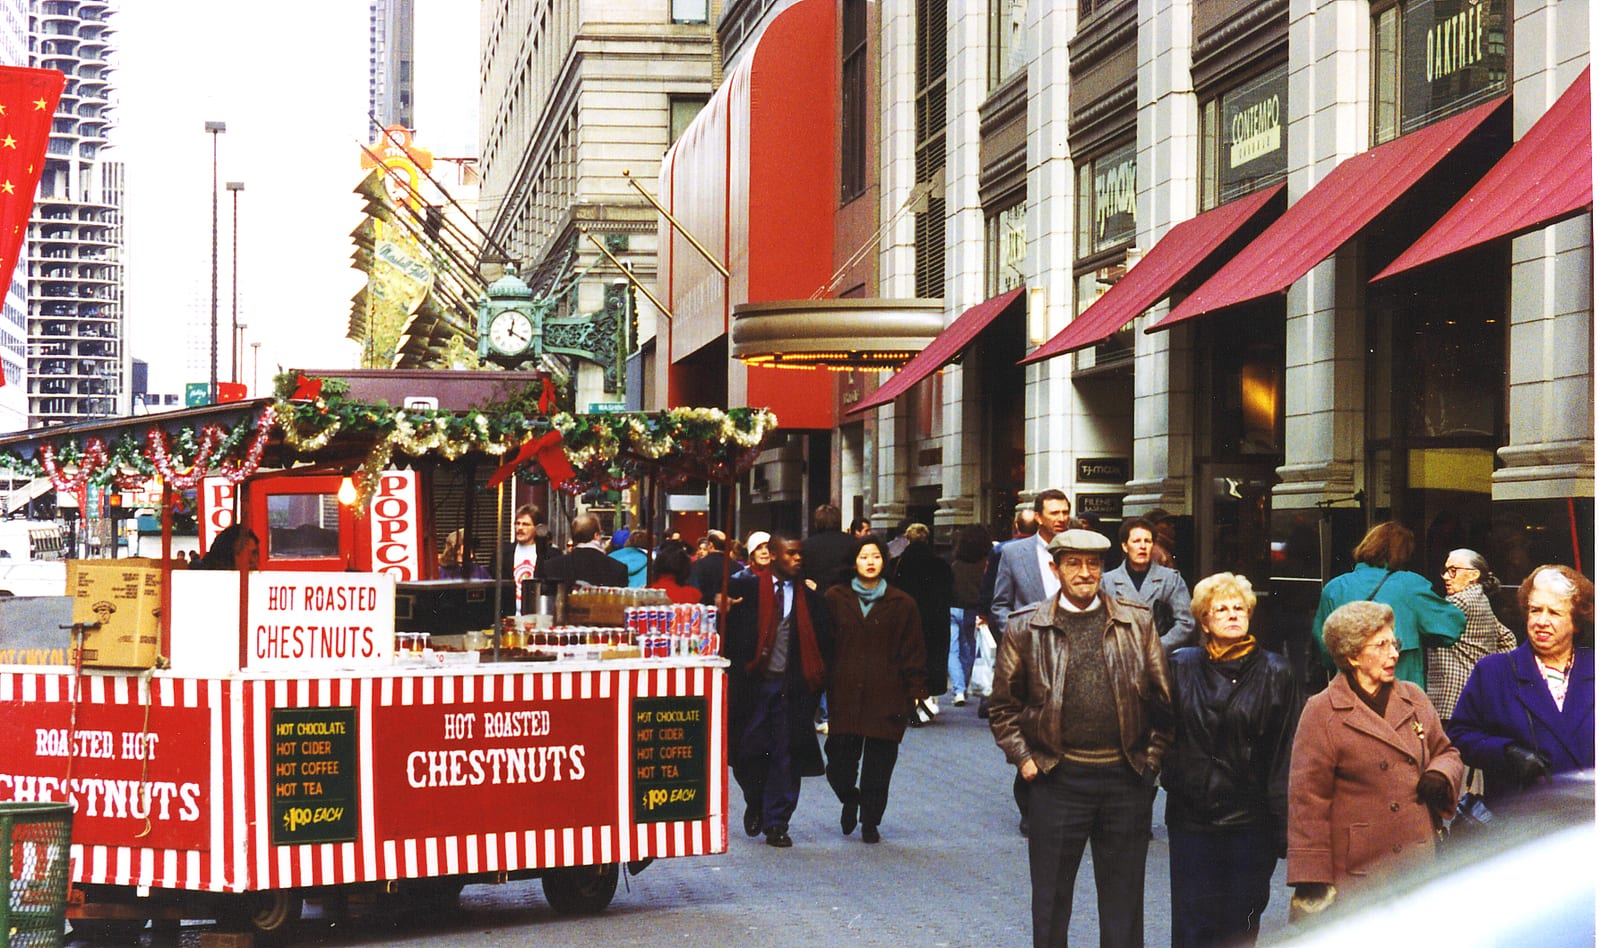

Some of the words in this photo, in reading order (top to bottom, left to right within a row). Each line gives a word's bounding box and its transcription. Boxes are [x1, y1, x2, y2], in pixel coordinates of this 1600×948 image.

[1427, 3, 1482, 82] OAKTREE
[1232, 94, 1280, 146] CONTEMPO
[268, 586, 296, 611] HOT
[304, 586, 377, 611] ROASTED
[256, 625, 381, 659] CHESTNUTS.
[637, 712, 652, 722] HOT
[656, 710, 700, 722] CHOCOLATE
[276, 723, 294, 736] HOT
[297, 721, 347, 736] CHOCOLATE
[444, 713, 477, 740] HOT
[484, 711, 550, 738] ROASTED
[637, 729, 654, 741] HOT
[658, 728, 684, 740] CIDER
[35, 729, 115, 759] ROASTED,
[121, 732, 159, 760] HOT
[276, 742, 297, 755] HOT
[301, 741, 332, 755] CIDER
[637, 747, 654, 760] HOT
[659, 746, 693, 759] COFFEE
[276, 763, 297, 776] HOT
[301, 761, 339, 775] COFFEE
[406, 745, 586, 788] CHESTNUTS
[637, 766, 655, 779] HOT
[661, 765, 679, 778] TEA
[276, 783, 297, 796] HOT
[302, 782, 323, 795] TEA
[670, 788, 696, 802] EACH
[313, 807, 344, 823] EACH
